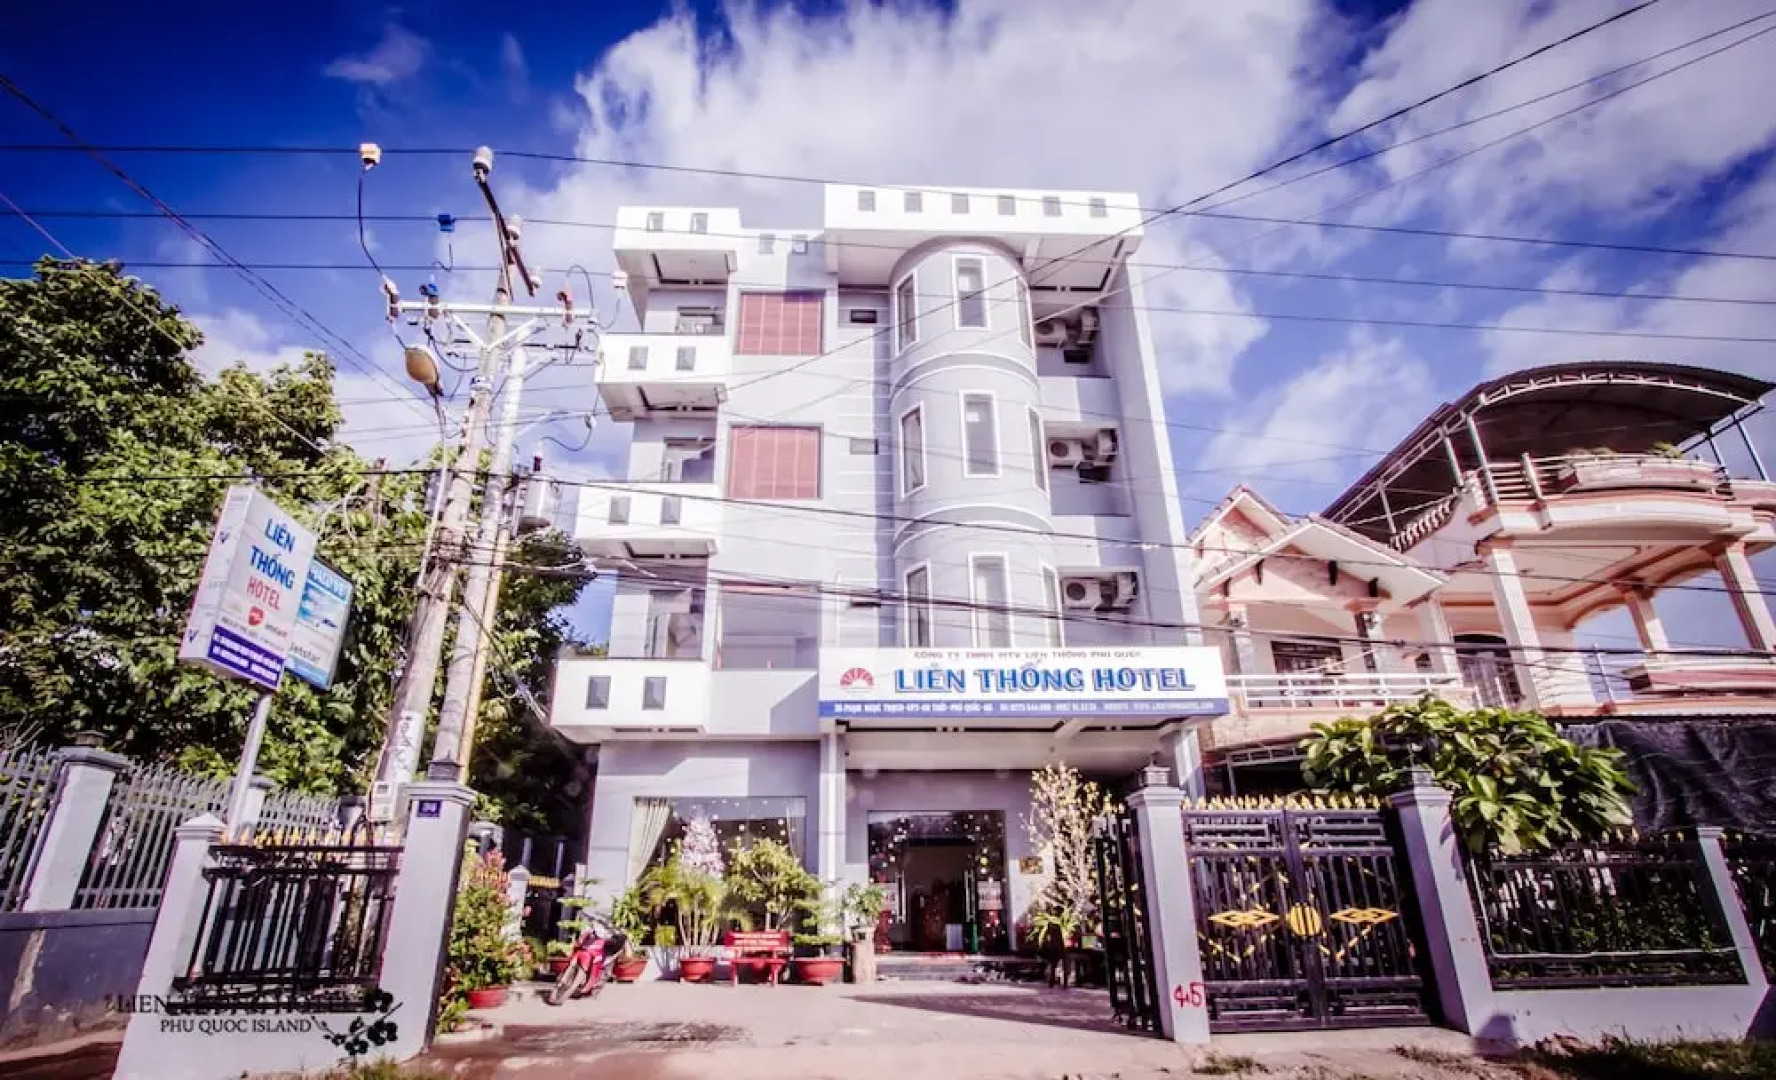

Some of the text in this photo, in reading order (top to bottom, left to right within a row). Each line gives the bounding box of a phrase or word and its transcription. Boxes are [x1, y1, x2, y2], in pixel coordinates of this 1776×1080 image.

[265, 518, 295, 553] LIÊN
[247, 575, 280, 610] HOTEL
[895, 659, 1195, 693] LIÊN THỐNG HOTEL
[1174, 982, 1206, 1008] 45
